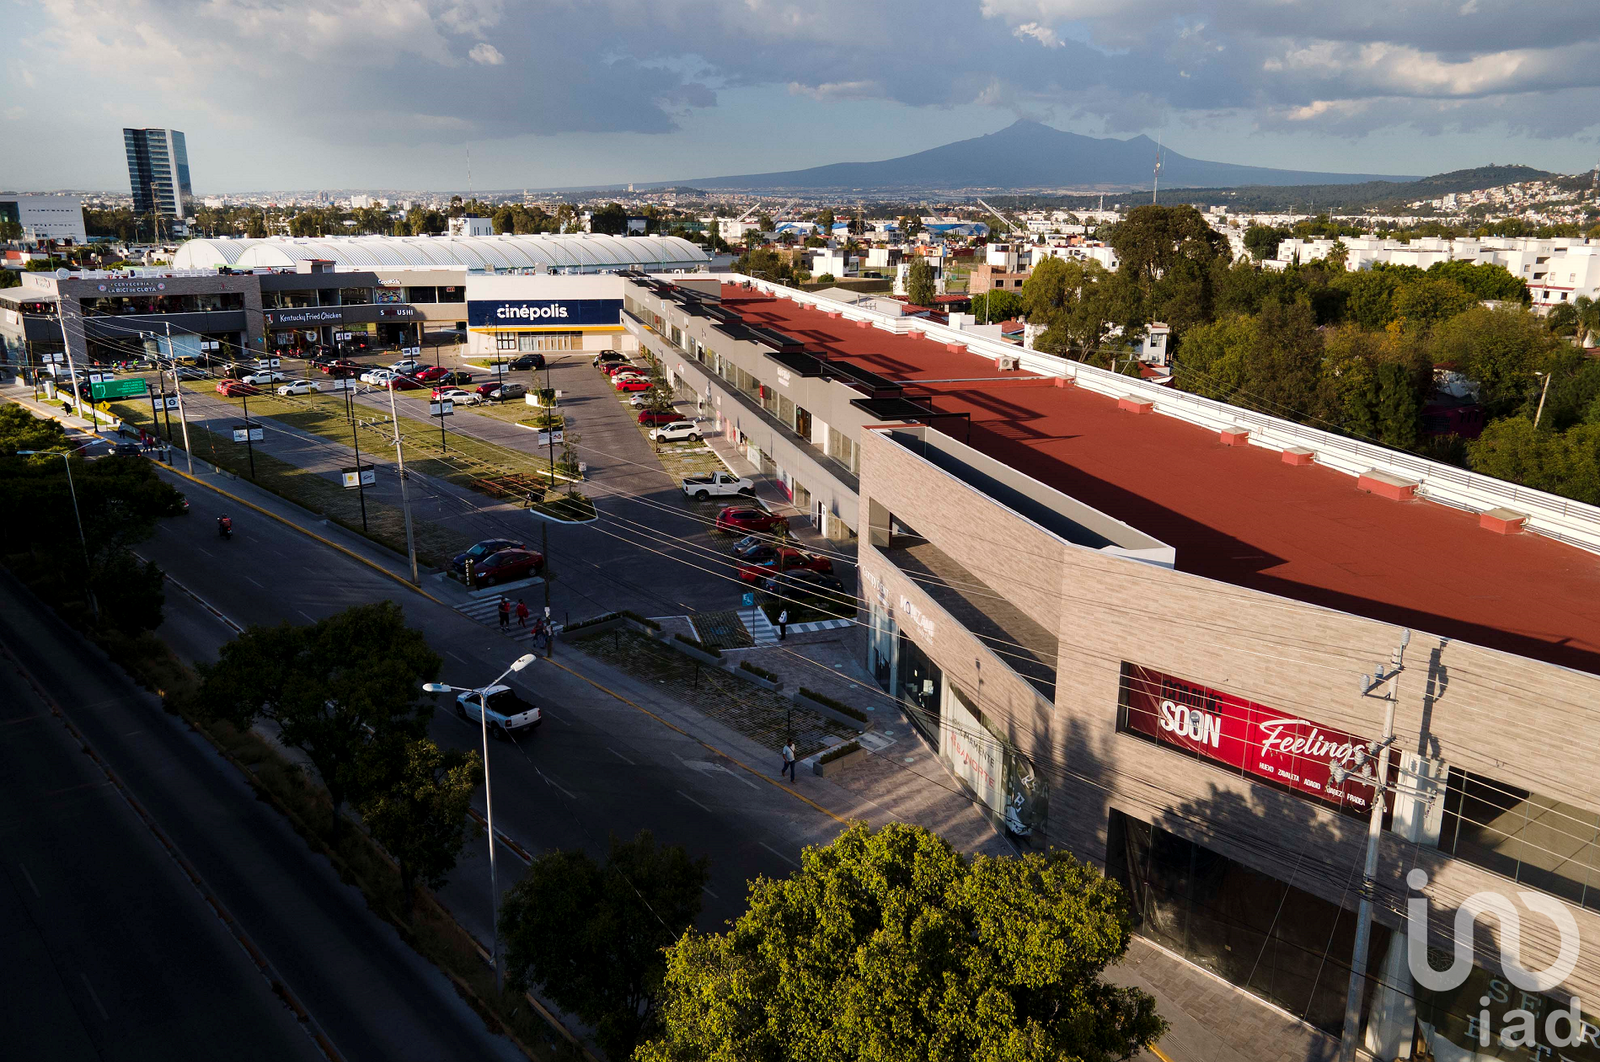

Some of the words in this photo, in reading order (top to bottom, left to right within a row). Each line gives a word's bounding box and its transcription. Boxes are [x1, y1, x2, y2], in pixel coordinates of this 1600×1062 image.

[279, 313, 306, 323] Kentucky
[305, 312, 320, 321] Fried
[320, 311, 342, 320] Chicken
[496, 303, 568, 320] cinépolis
[1162, 680, 1223, 717] COMING
[1160, 700, 1221, 748] SOON
[1260, 719, 1366, 767] Feelings
[956, 742, 995, 789] BANORTE
